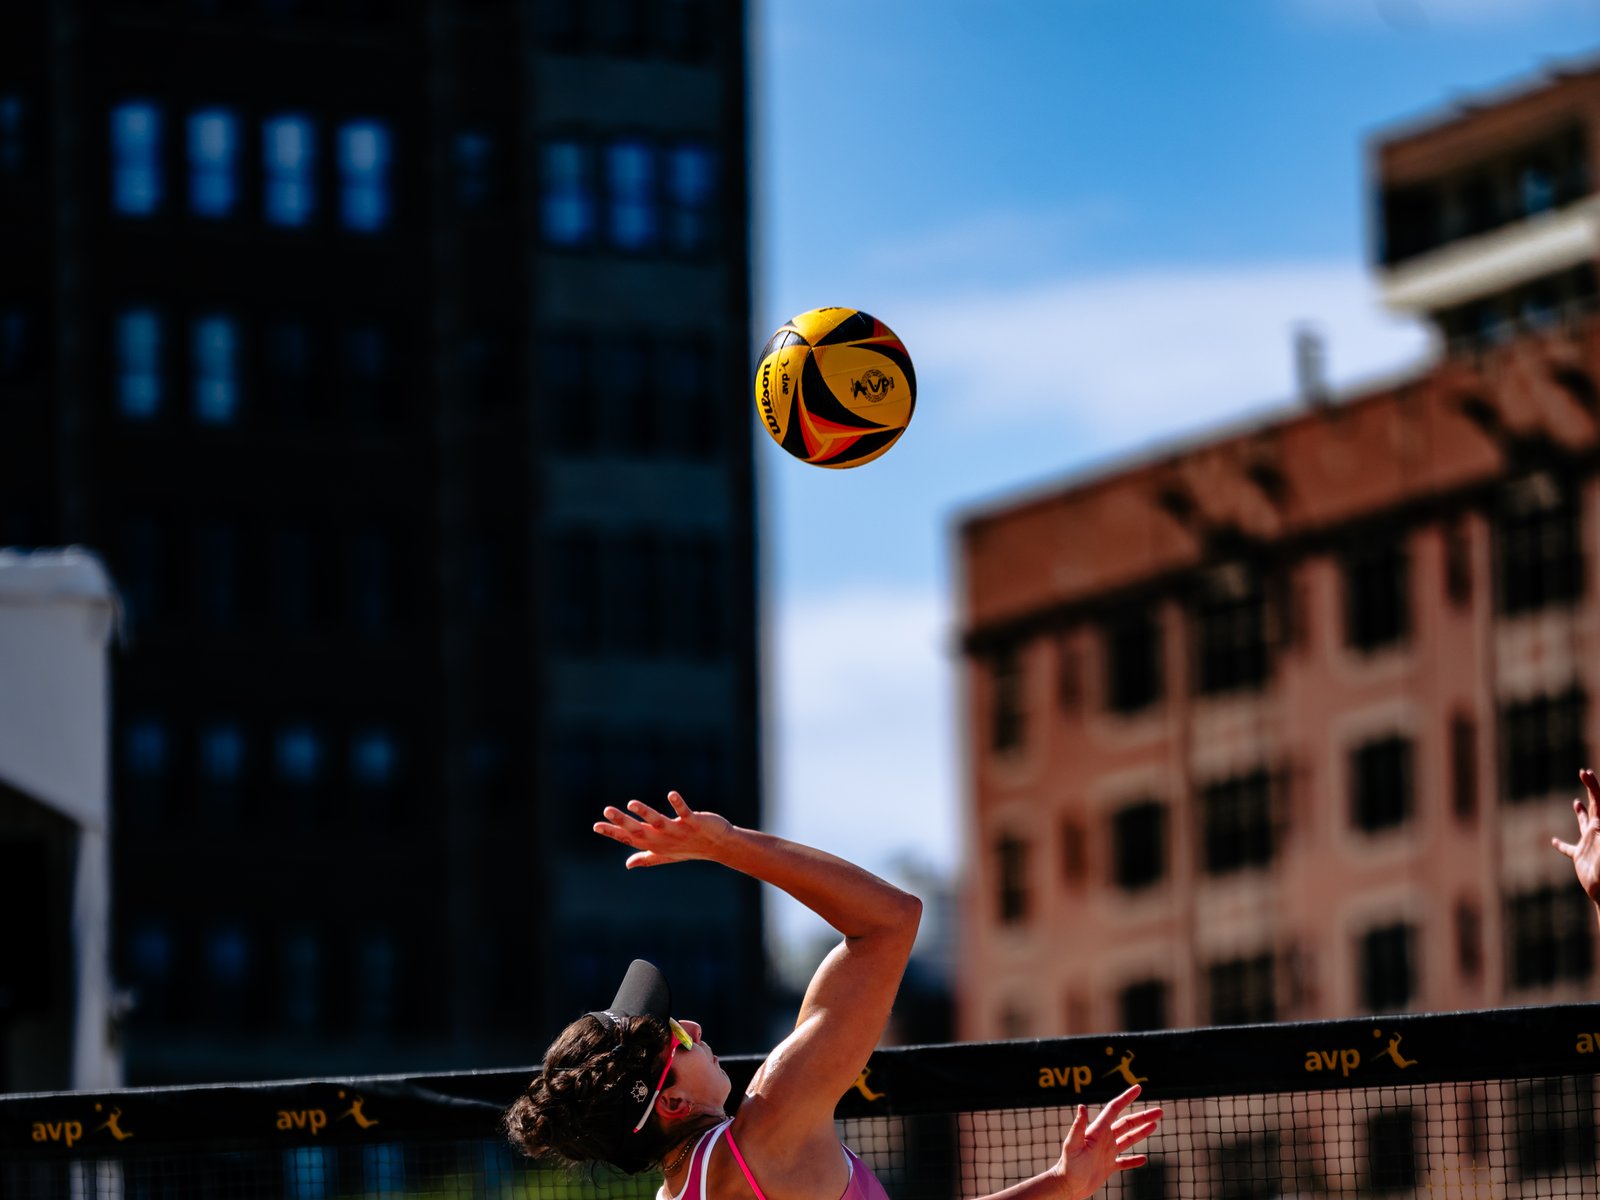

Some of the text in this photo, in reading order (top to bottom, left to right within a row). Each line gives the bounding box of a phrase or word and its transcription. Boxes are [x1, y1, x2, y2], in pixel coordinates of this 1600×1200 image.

[1304, 1048, 1360, 1077] avp
[1039, 1065, 1092, 1094] avp
[32, 1120, 83, 1147] avp
[276, 1109, 327, 1135] avp
